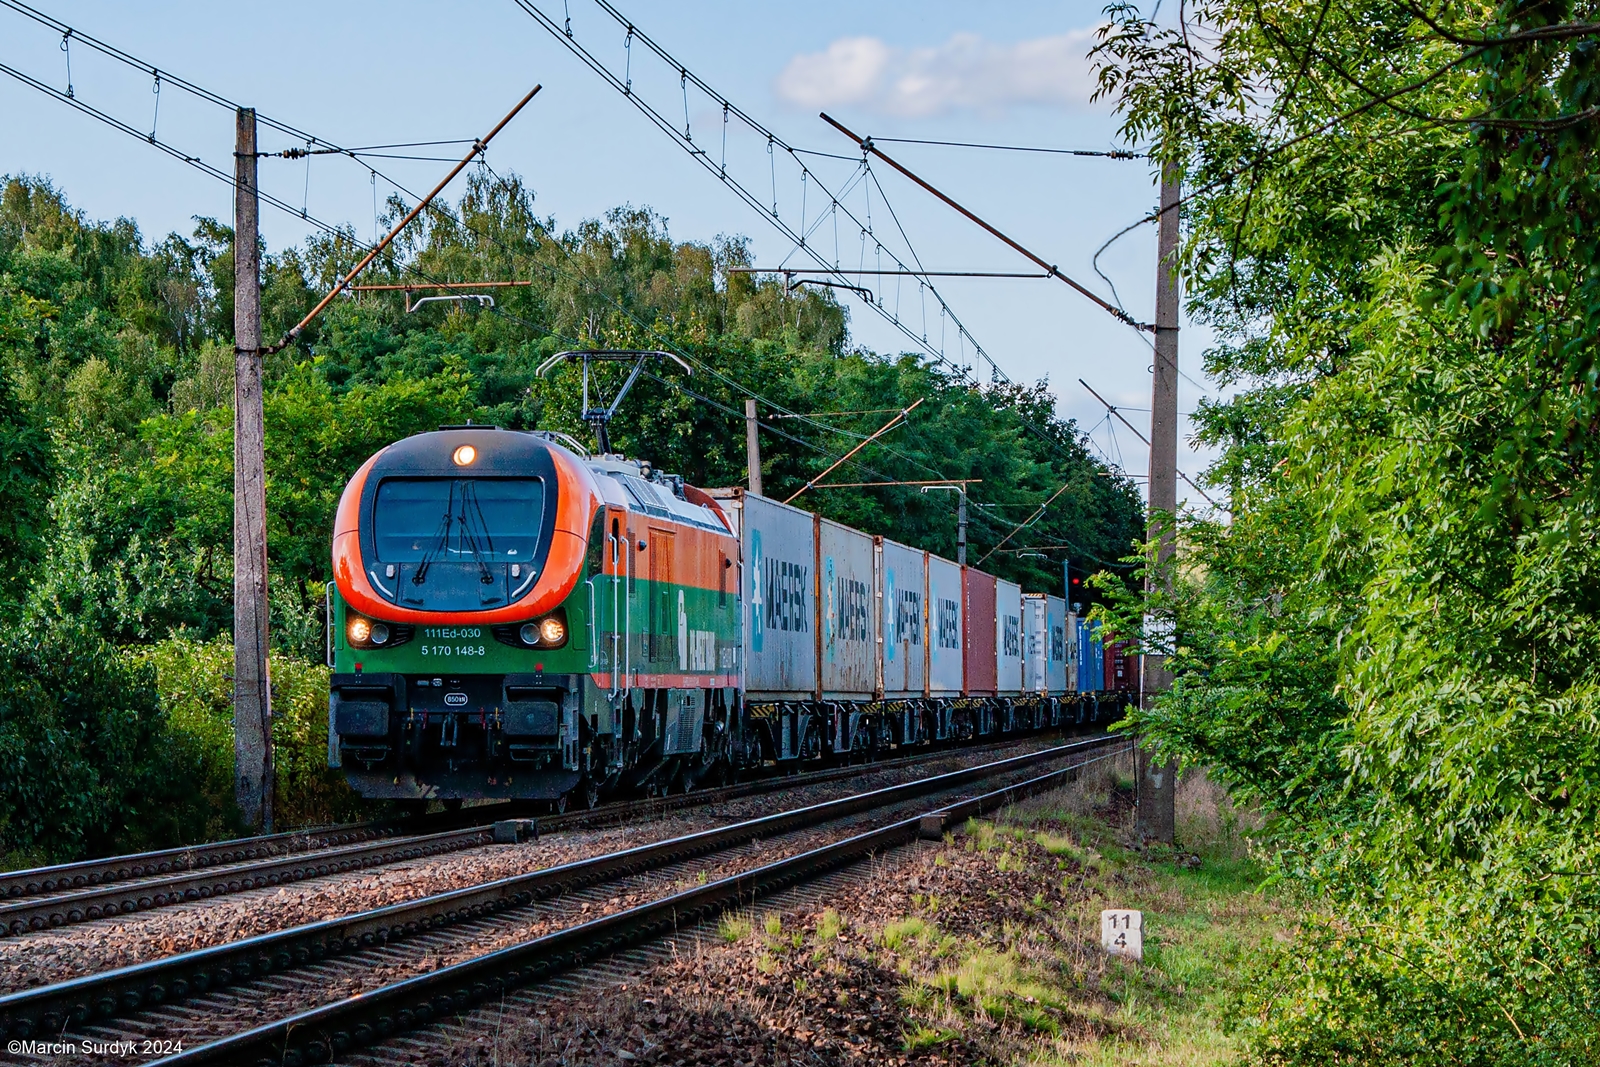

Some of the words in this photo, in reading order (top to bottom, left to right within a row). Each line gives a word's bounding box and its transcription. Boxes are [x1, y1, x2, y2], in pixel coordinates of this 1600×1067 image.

[765, 557, 808, 633] MAERSK
[837, 576, 871, 642] MAERSK
[424, 628, 481, 638] 111Ed-030
[421, 645, 428, 655] 5
[432, 645, 451, 655] 170
[455, 645, 485, 655] 148-8
[1108, 913, 1130, 929] 11
[1114, 932, 1127, 948] 4
